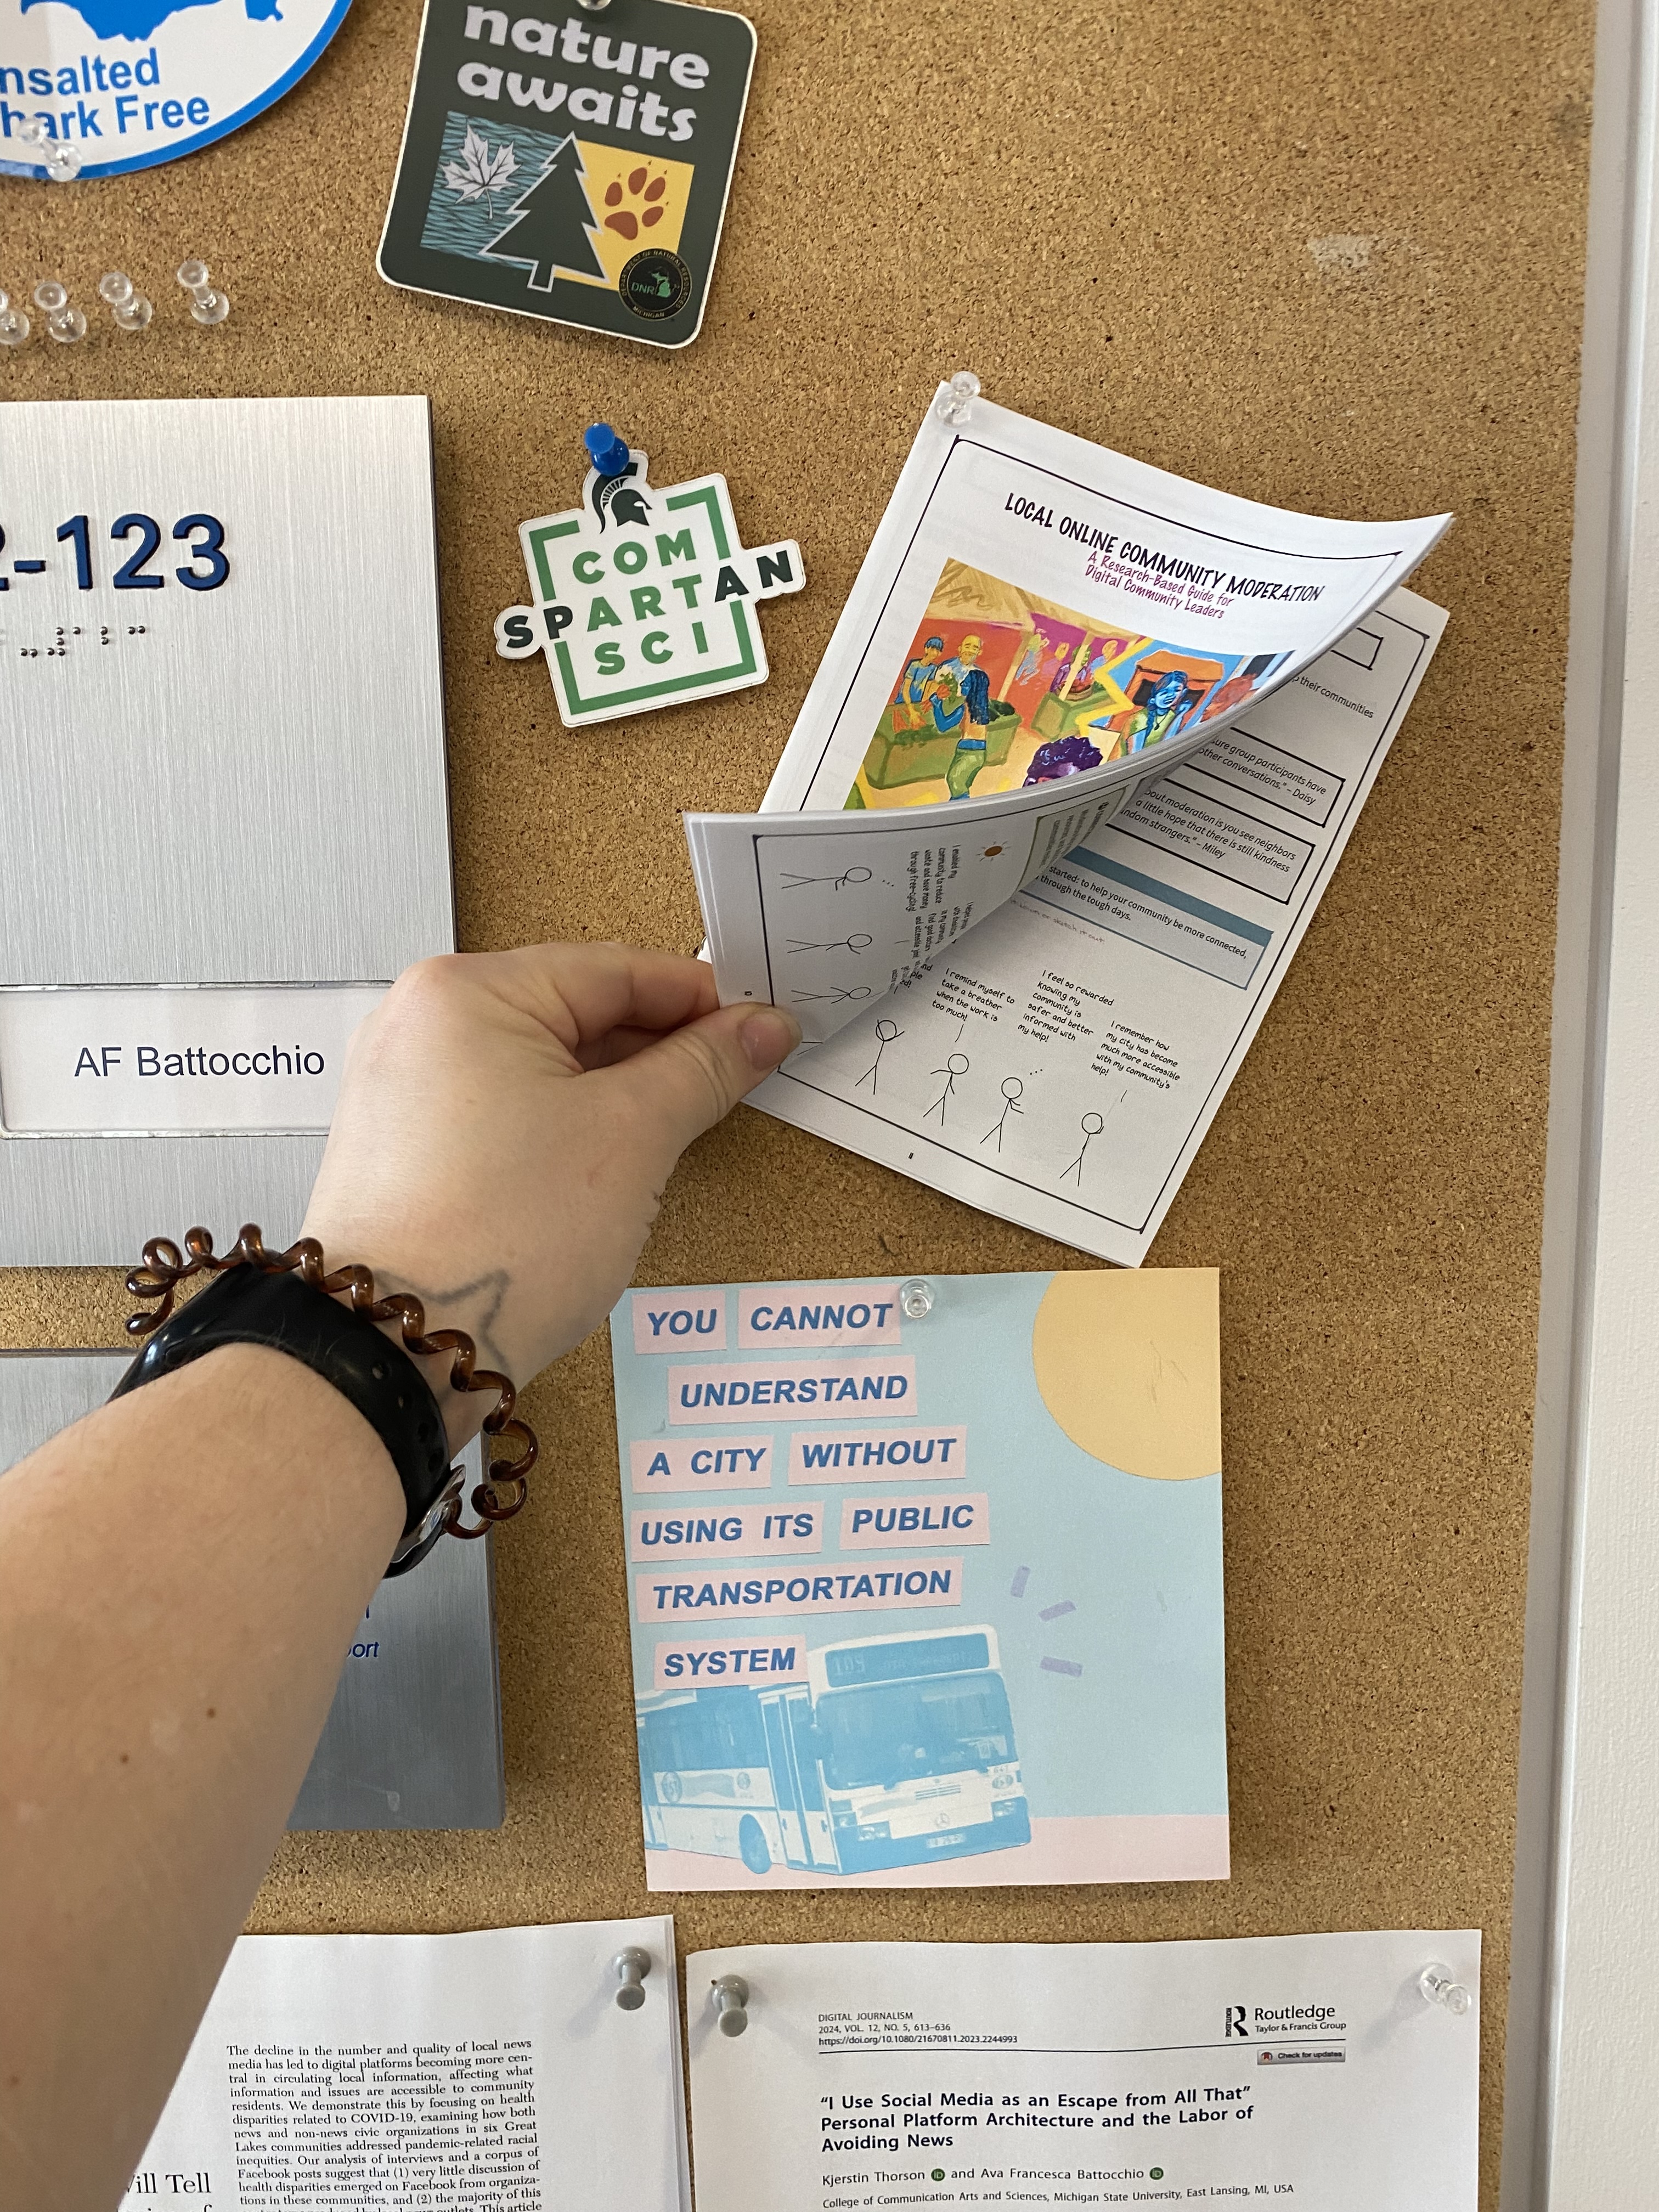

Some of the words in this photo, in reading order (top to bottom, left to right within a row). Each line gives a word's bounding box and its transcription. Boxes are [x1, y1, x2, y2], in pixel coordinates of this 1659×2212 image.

[464, 5, 709, 90] nature
[116, 94, 210, 134] Free
[457, 61, 697, 142] awaits
[631, 282, 654, 295] DNR
[0, 513, 230, 591] -123
[573, 528, 697, 584] COM
[1005, 493, 1053, 528] LOCAL
[1059, 516, 1118, 553] ONLINE
[1120, 542, 1227, 589] COMMUNITY
[1226, 576, 1325, 601] MODERATION
[1085, 564, 1122, 588] Digital
[1124, 579, 1183, 610] Community
[1184, 599, 1224, 619] Leaders
[1087, 551, 1097, 564] A
[1101, 555, 1186, 594] Research-Based
[1188, 585, 1214, 602] Guide
[1217, 593, 1234, 606] for
[594, 622, 709, 675] SCI
[1300, 676, 1322, 692] their
[1321, 689, 1374, 718] communities
[1228, 746, 1256, 762] group
[1254, 758, 1306, 785] participants
[1306, 779, 1327, 794] have
[1292, 788, 1317, 805] Daisy
[1121, 809, 1149, 825] ndom
[1202, 843, 1226, 859] Miley
[1143, 801, 1164, 815] little
[1164, 810, 1186, 826] hope
[1187, 821, 1206, 834] that
[1206, 830, 1228, 844] there
[1228, 839, 1237, 848] is
[1237, 845, 1255, 856] still
[1253, 850, 1290, 872] kindness
[1165, 798, 1215, 824] moderation
[1215, 818, 1223, 827] is
[1221, 823, 1239, 834] you
[1239, 831, 1255, 841] see
[1254, 838, 1296, 860] neighbors
[1041, 874, 1071, 894] through
[1073, 889, 1086, 900] the
[1087, 895, 1110, 911] tough
[1111, 906, 1131, 921] days.
[1081, 879, 1090, 888] to
[1090, 882, 1108, 897] help
[1107, 892, 1128, 904] your
[1128, 901, 1173, 926] community
[1173, 919, 1183, 929] be
[1184, 926, 1205, 939] more
[1205, 936, 1247, 959] connected,
[942, 979, 959, 991] take
[968, 990, 1002, 1010] breather
[950, 972, 978, 986] remind
[978, 984, 1005, 998] myself
[1007, 995, 1014, 1003] to
[932, 1000, 944, 1010] too
[946, 1008, 968, 1022] much!
[936, 991, 953, 1002] when
[956, 998, 968, 1008] the
[970, 1006, 989, 1019] work
[1106, 1033, 1117, 1043] my
[1119, 1039, 1135, 1050] city
[1136, 1044, 1149, 1054] has
[1150, 1050, 1178, 1067] become
[1115, 1024, 1154, 1043] remember
[1155, 1040, 1170, 1051] how
[75, 1047, 121, 1077] AF
[137, 1045, 324, 1076] Battocchio
[1091, 1063, 1109, 1076] help!
[1096, 1054, 1111, 1064] with
[1113, 1061, 1124, 1071] my
[1126, 1066, 1170, 1088] community's
[1101, 1043, 1120, 1055] much
[1121, 1052, 1141, 1064] more
[1143, 1062, 1180, 1080] accessible
[647, 1309, 716, 1336] YOU
[751, 1304, 893, 1331] CANNOT
[681, 1375, 907, 1407] UNDERSTAND
[647, 1452, 671, 1476] A
[691, 1448, 767, 1474] CITY
[803, 1438, 957, 1468] WITHOUT
[642, 1517, 742, 1545] USING
[764, 1514, 813, 1539] ITS
[853, 1505, 974, 1533] PUBLIC
[653, 1570, 951, 1609] TRANSPORTATION
[664, 1647, 795, 1677] SYSTEM
[819, 2013, 852, 2022] DIGITAL
[856, 2012, 913, 2020] JOURNALISM
[819, 2025, 842, 2034] 2024,
[903, 2024, 910, 2032] 5,
[1255, 2005, 1335, 2021] Routledge
[1255, 2024, 1279, 2034] Taylor
[1320, 2022, 1346, 2030] Group
[226, 2045, 249, 2056] The
[255, 2045, 294, 2055] decline
[299, 2046, 309, 2055] in
[315, 2045, 332, 2056] the
[338, 2044, 382, 2055] number
[387, 2043, 407, 2054] and
[413, 2043, 452, 2056] quality
[455, 2041, 467, 2052] of
[472, 2039, 498, 2051] local
[504, 2041, 532, 2049] news
[842, 2095, 873, 2108] Use
[882, 2092, 931, 2107] Social
[941, 2092, 993, 2106] Media
[1002, 2096, 1019, 2106] as
[1029, 2097, 1048, 2107] an
[1058, 2094, 1118, 2111] Escape
[1125, 2092, 1166, 2107] from
[1175, 2089, 1196, 2103] All
[822, 2114, 894, 2131] Personal
[904, 2113, 977, 2127] Platform
[986, 2113, 1093, 2127] Architecture
[1102, 2113, 1134, 2127] and
[1143, 2112, 1171, 2125] the
[1180, 2108, 1228, 2123] Labor
[1236, 2105, 1254, 2119] of
[822, 2135, 899, 2152] Avoiding
[908, 2134, 953, 2147] News
[127, 2172, 157, 2193] ill
[165, 2172, 212, 2193] Tell
[823, 2172, 868, 2188] Kjerstin
[874, 2171, 924, 2182] Thorson
[951, 2168, 974, 2178] and
[981, 2168, 1003, 2178] Ava
[1011, 2168, 1070, 2179] Francesca
[1078, 2169, 1144, 2180] Battocchio
